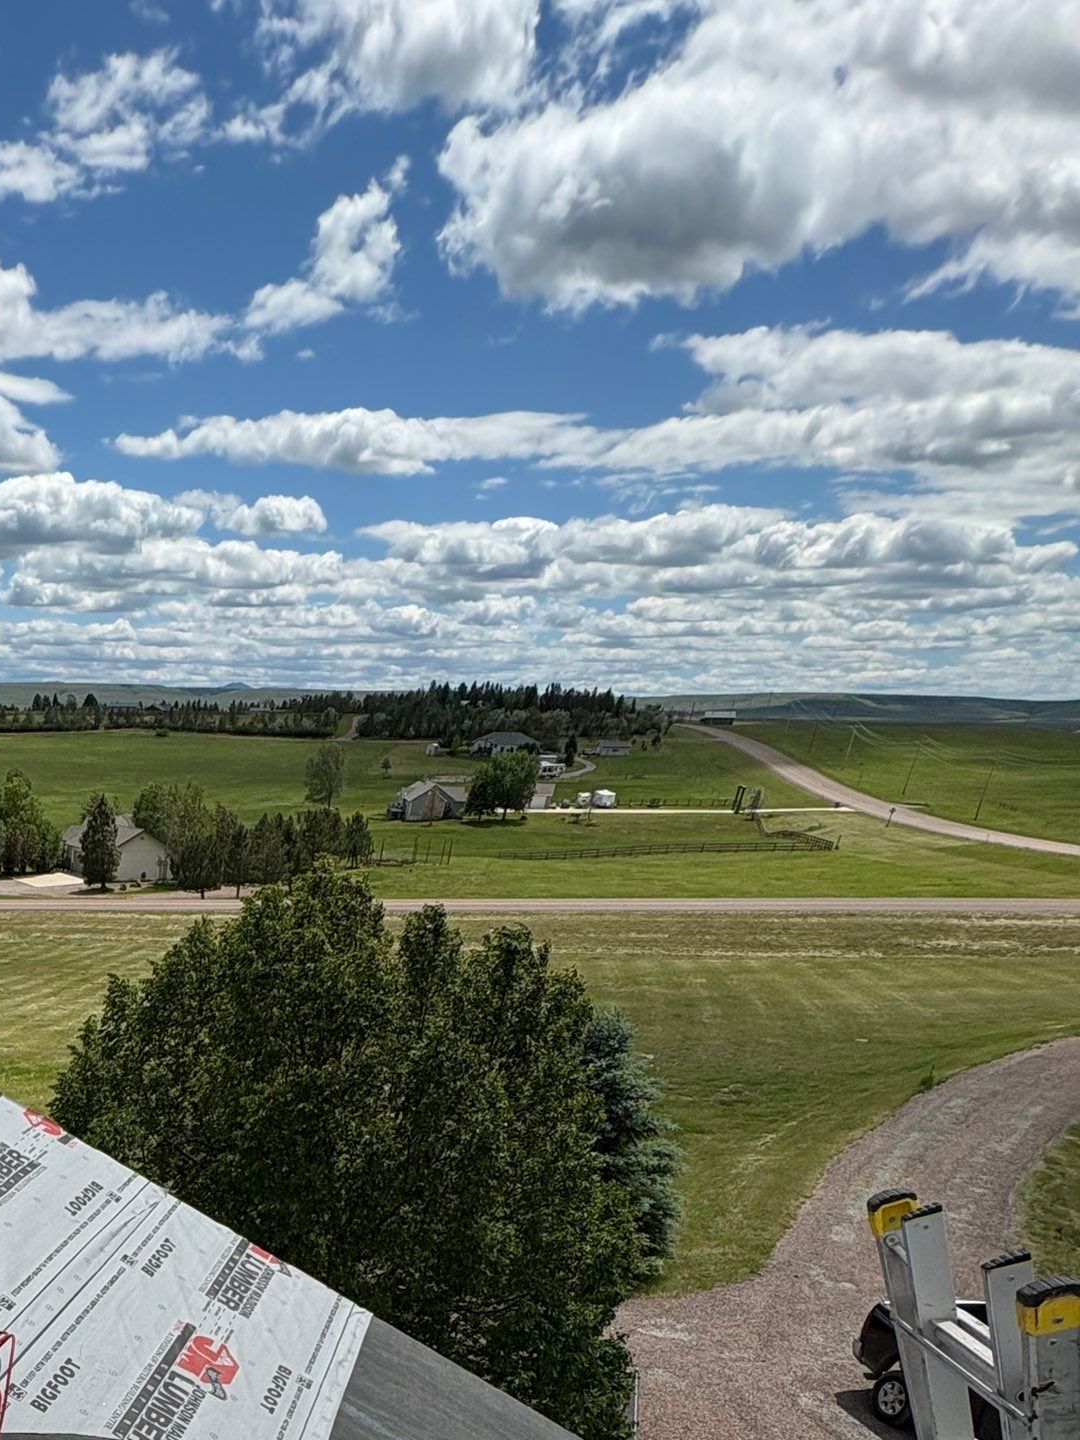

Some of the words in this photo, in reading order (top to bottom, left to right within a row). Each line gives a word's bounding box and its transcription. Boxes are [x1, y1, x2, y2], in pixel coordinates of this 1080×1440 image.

[65, 1181, 103, 1216] BIGFOOT
[141, 1238, 175, 1277] BIGFOOT
[213, 1254, 269, 1311] LUMBER
[23, 1358, 80, 1412] BIGFOOT
[173, 1385, 207, 1424] JOHNSON
[261, 1365, 298, 1414] BIGFOOT
